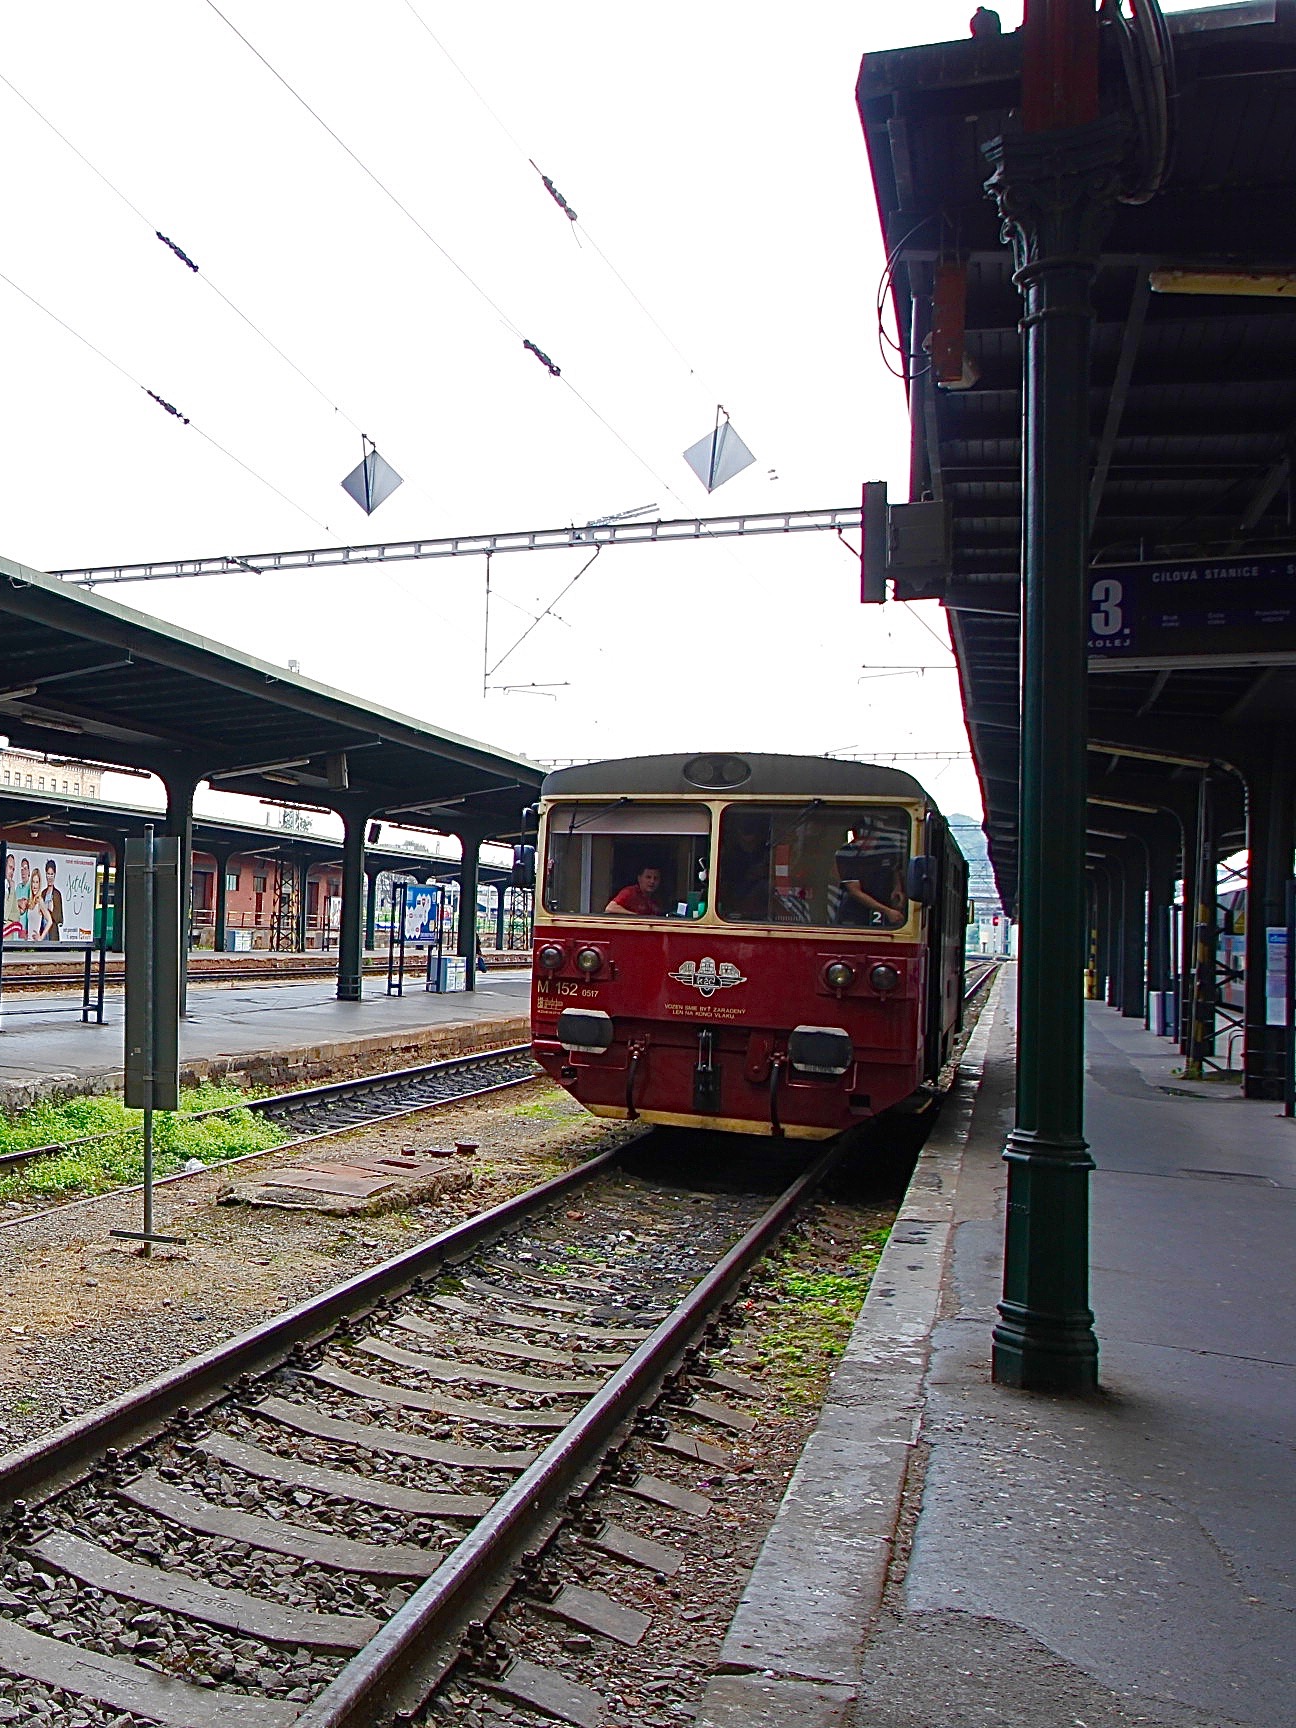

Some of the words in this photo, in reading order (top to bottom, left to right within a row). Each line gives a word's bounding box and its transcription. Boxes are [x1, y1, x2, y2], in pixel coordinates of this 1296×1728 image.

[1091, 578, 1131, 636] 3.
[872, 911, 882, 923] 2
[537, 979, 549, 994] M
[555, 981, 579, 996] 152
[581, 989, 600, 998] 0517
